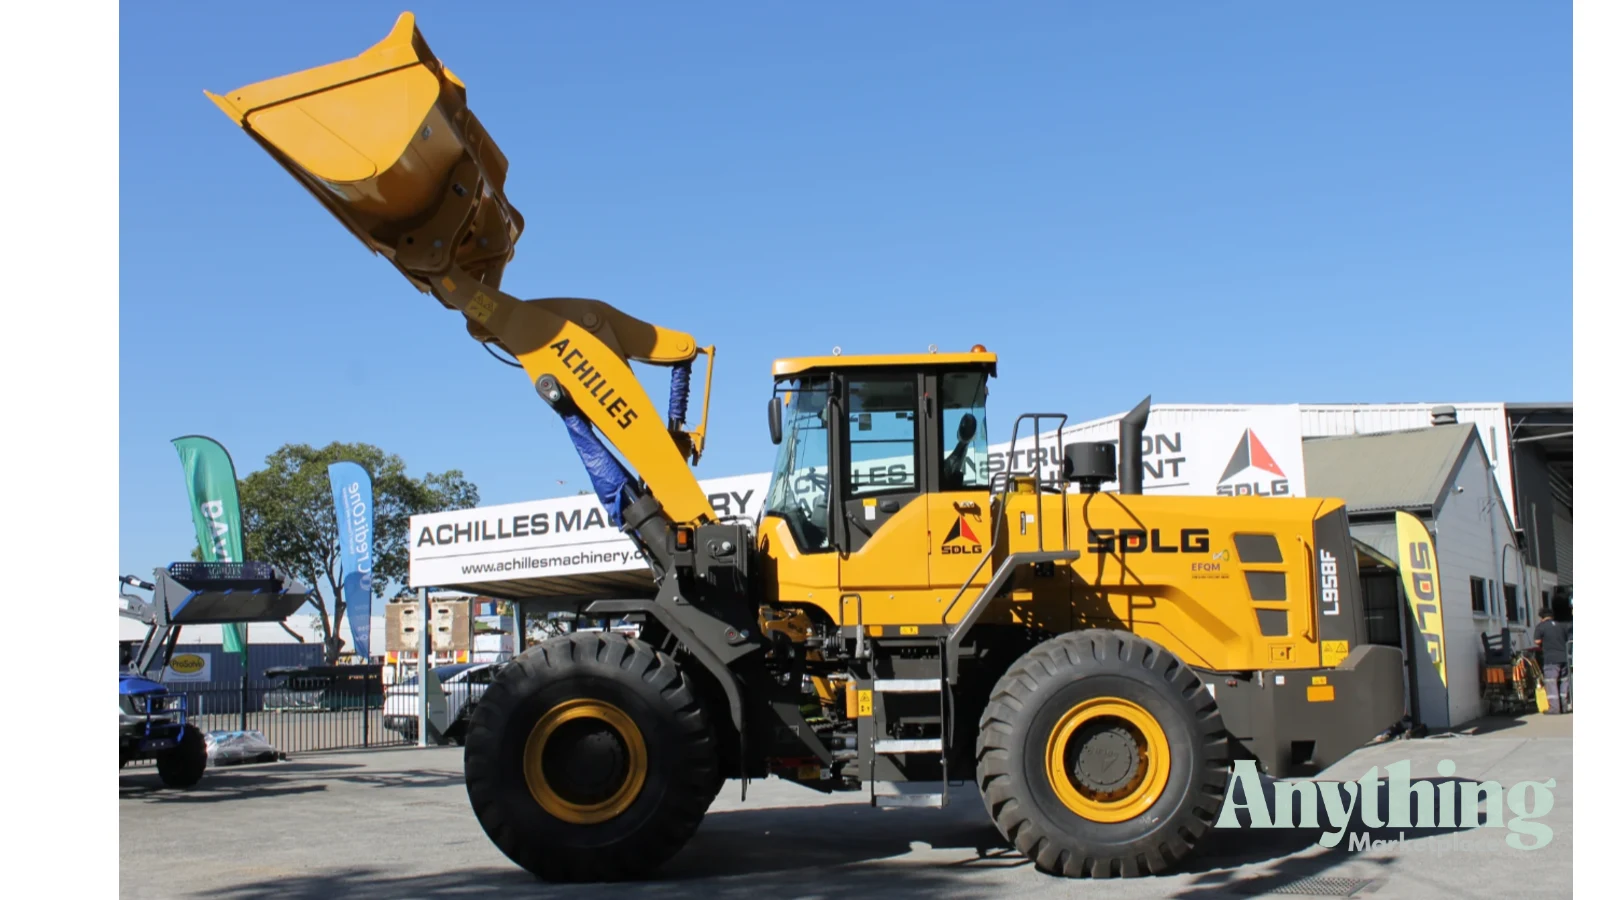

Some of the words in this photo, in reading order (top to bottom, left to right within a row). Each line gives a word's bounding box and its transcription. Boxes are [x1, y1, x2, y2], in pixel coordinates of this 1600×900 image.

[550, 338, 638, 430] ACHILLES
[1216, 479, 1289, 497] SDLG
[417, 513, 549, 547] ACHILLES
[1087, 528, 1209, 553] SDLG
[941, 545, 982, 555] SDLG
[1191, 562, 1221, 572] EFQM
[1320, 549, 1340, 615] L958F
[1409, 542, 1442, 664] SDLG
